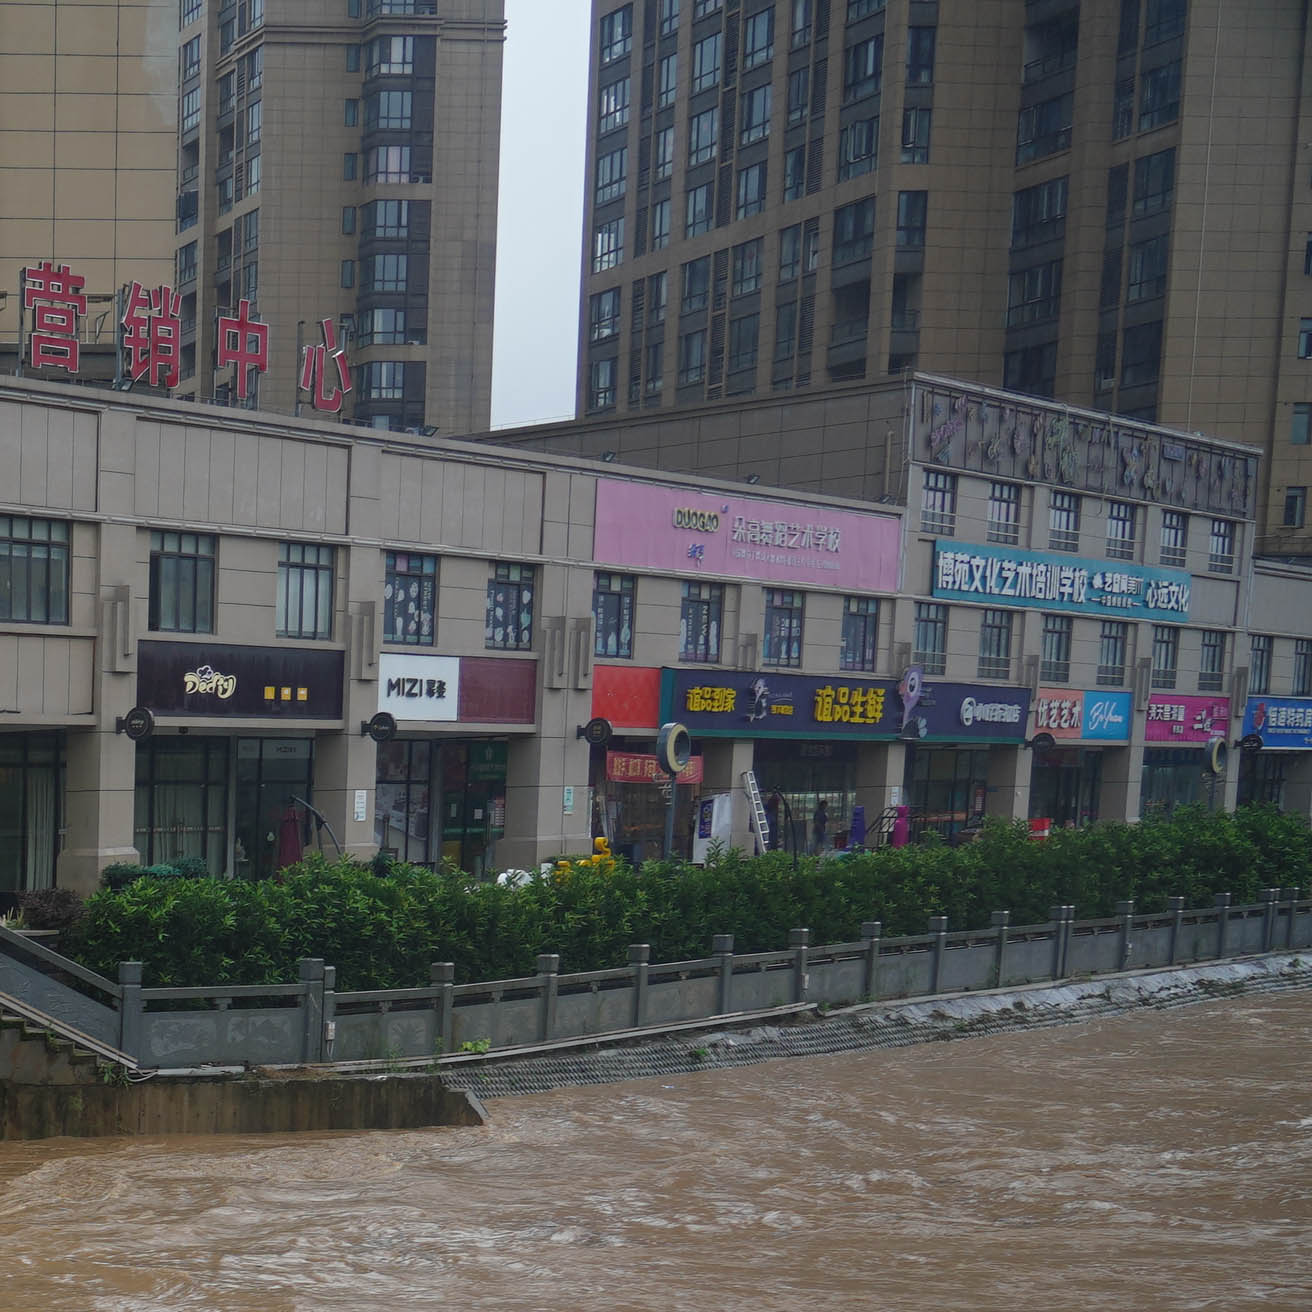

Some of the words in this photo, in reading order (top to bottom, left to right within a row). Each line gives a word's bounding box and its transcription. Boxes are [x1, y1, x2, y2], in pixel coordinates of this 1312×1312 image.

[26, 261, 352, 412] 营销中心
[673, 507, 720, 533] DUOGAO
[732, 516, 841, 553] 朵高舞蹈艺术学校
[938, 551, 1088, 604] 博苑文化艺术培训学校
[387, 678, 423, 698] MIZI
[687, 686, 736, 713] 谊品到家
[815, 685, 885, 724] 谊品生鲜
